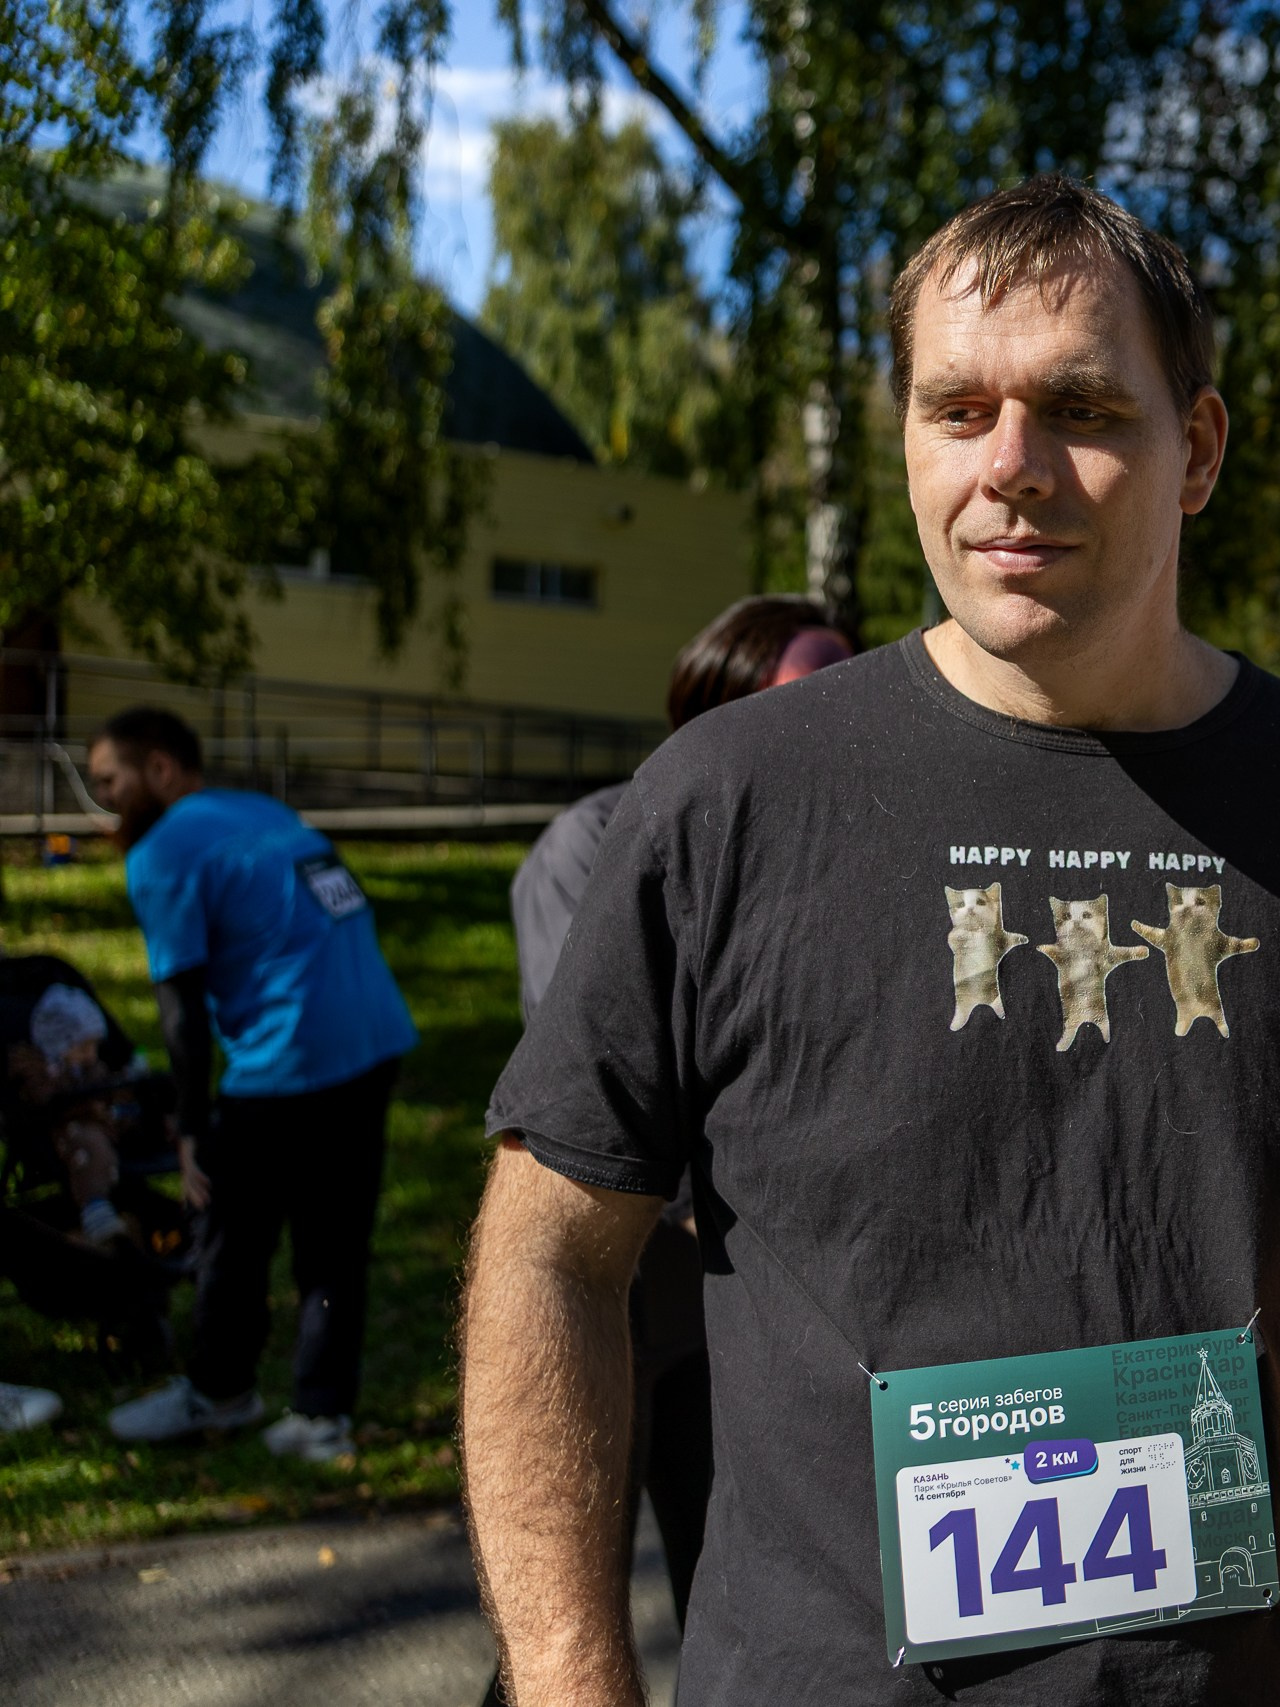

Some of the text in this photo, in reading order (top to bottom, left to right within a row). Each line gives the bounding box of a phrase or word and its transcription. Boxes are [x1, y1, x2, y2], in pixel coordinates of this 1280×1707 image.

[950, 846, 1226, 874] HAPPY HAPPY HAPPY
[938, 1387, 1063, 1414] серия забегов
[1115, 1388, 1178, 1406] Казань
[909, 1402, 1066, 1441] 5 городов
[1035, 1452, 1048, 1468] 2
[1118, 1447, 1142, 1456] спорт
[1119, 1457, 1135, 1466] для
[1120, 1465, 1147, 1475] жизни
[913, 1473, 949, 1484] КАЗАНЬ
[914, 1475, 1013, 1494] Парк «Крылья Советов»
[915, 1489, 966, 1502] 14 сентября
[928, 1484, 1167, 1618] 144
